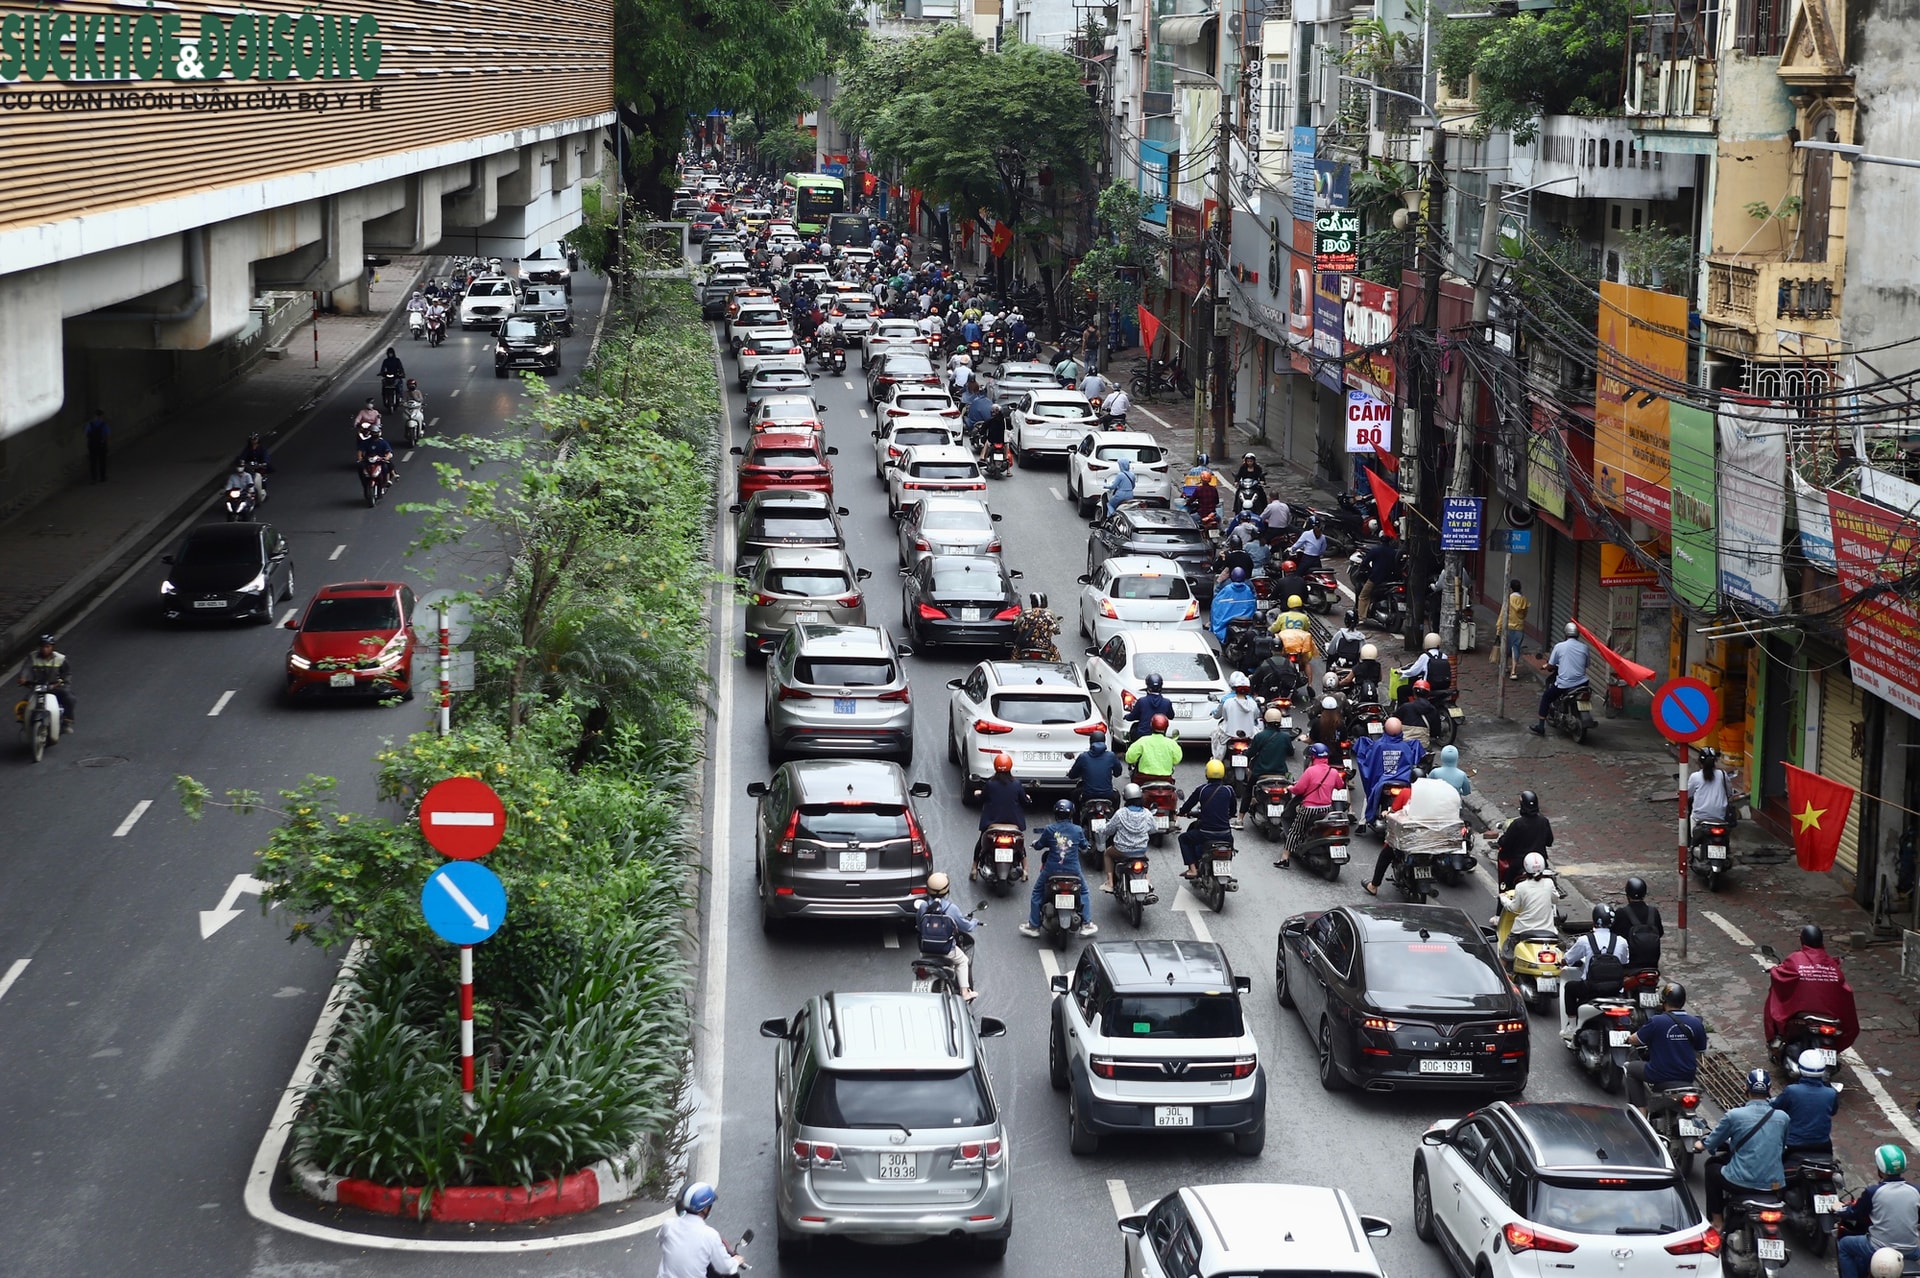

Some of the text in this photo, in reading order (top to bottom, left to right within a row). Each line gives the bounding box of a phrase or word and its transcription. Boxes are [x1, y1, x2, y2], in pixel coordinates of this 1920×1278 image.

[1352, 392, 1366, 400] 252
[1349, 400, 1391, 422] CẦM
[1357, 423, 1382, 445] ĐỒ
[1286, 616, 1303, 629] be
[1166, 1107, 1182, 1116] 30L
[1159, 1116, 1188, 1125] 871.81
[889, 1154, 908, 1165] 30A
[881, 1167, 916, 1178] 219.38
